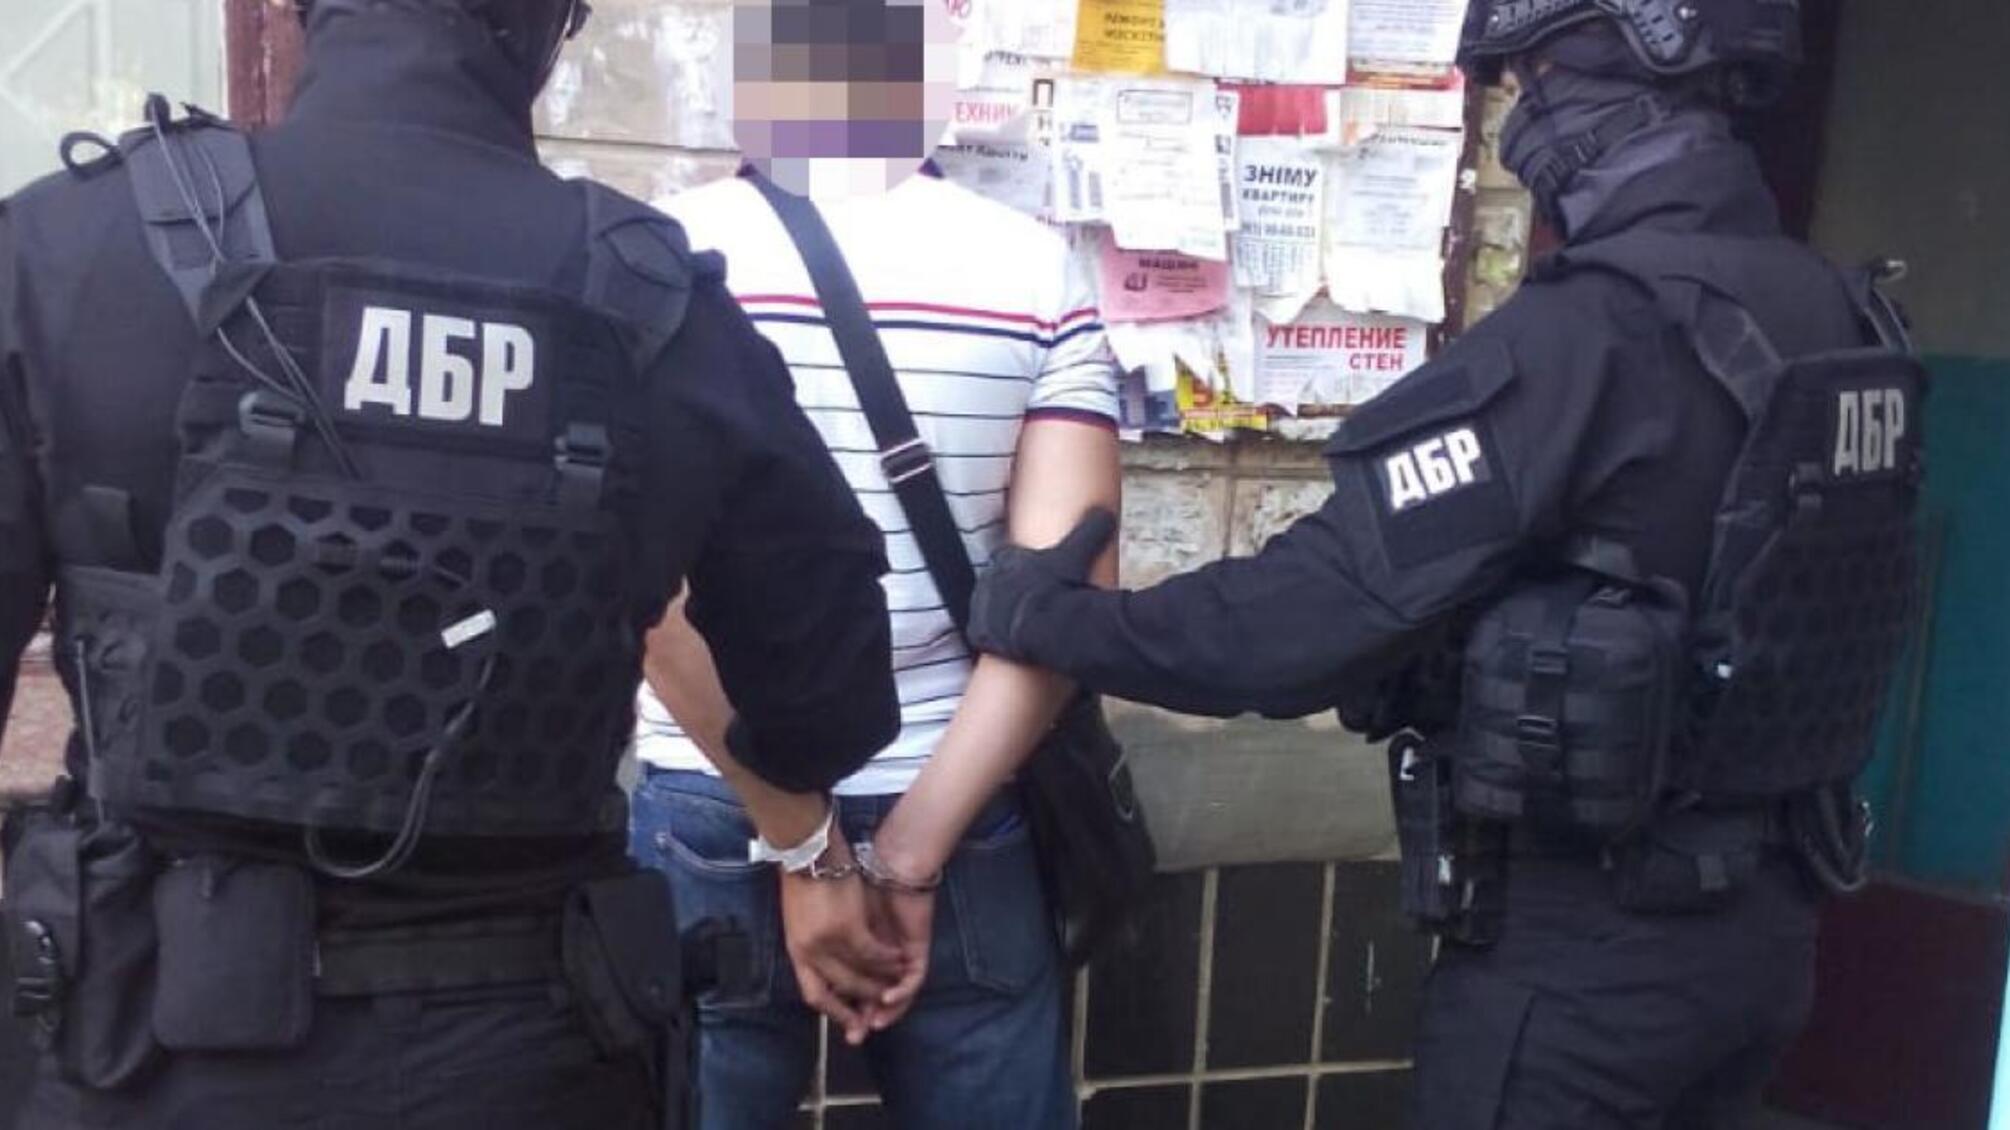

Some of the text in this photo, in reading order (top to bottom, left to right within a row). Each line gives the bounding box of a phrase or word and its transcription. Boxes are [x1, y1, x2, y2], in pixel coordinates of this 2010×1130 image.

[344, 306, 534, 426] ДБР
[1266, 325, 1406, 349] УТЕПЛЕНИЕ
[1349, 353, 1403, 371] СТЕН
[1387, 428, 1481, 511] ДБР
[1834, 388, 1905, 476] ДБР
